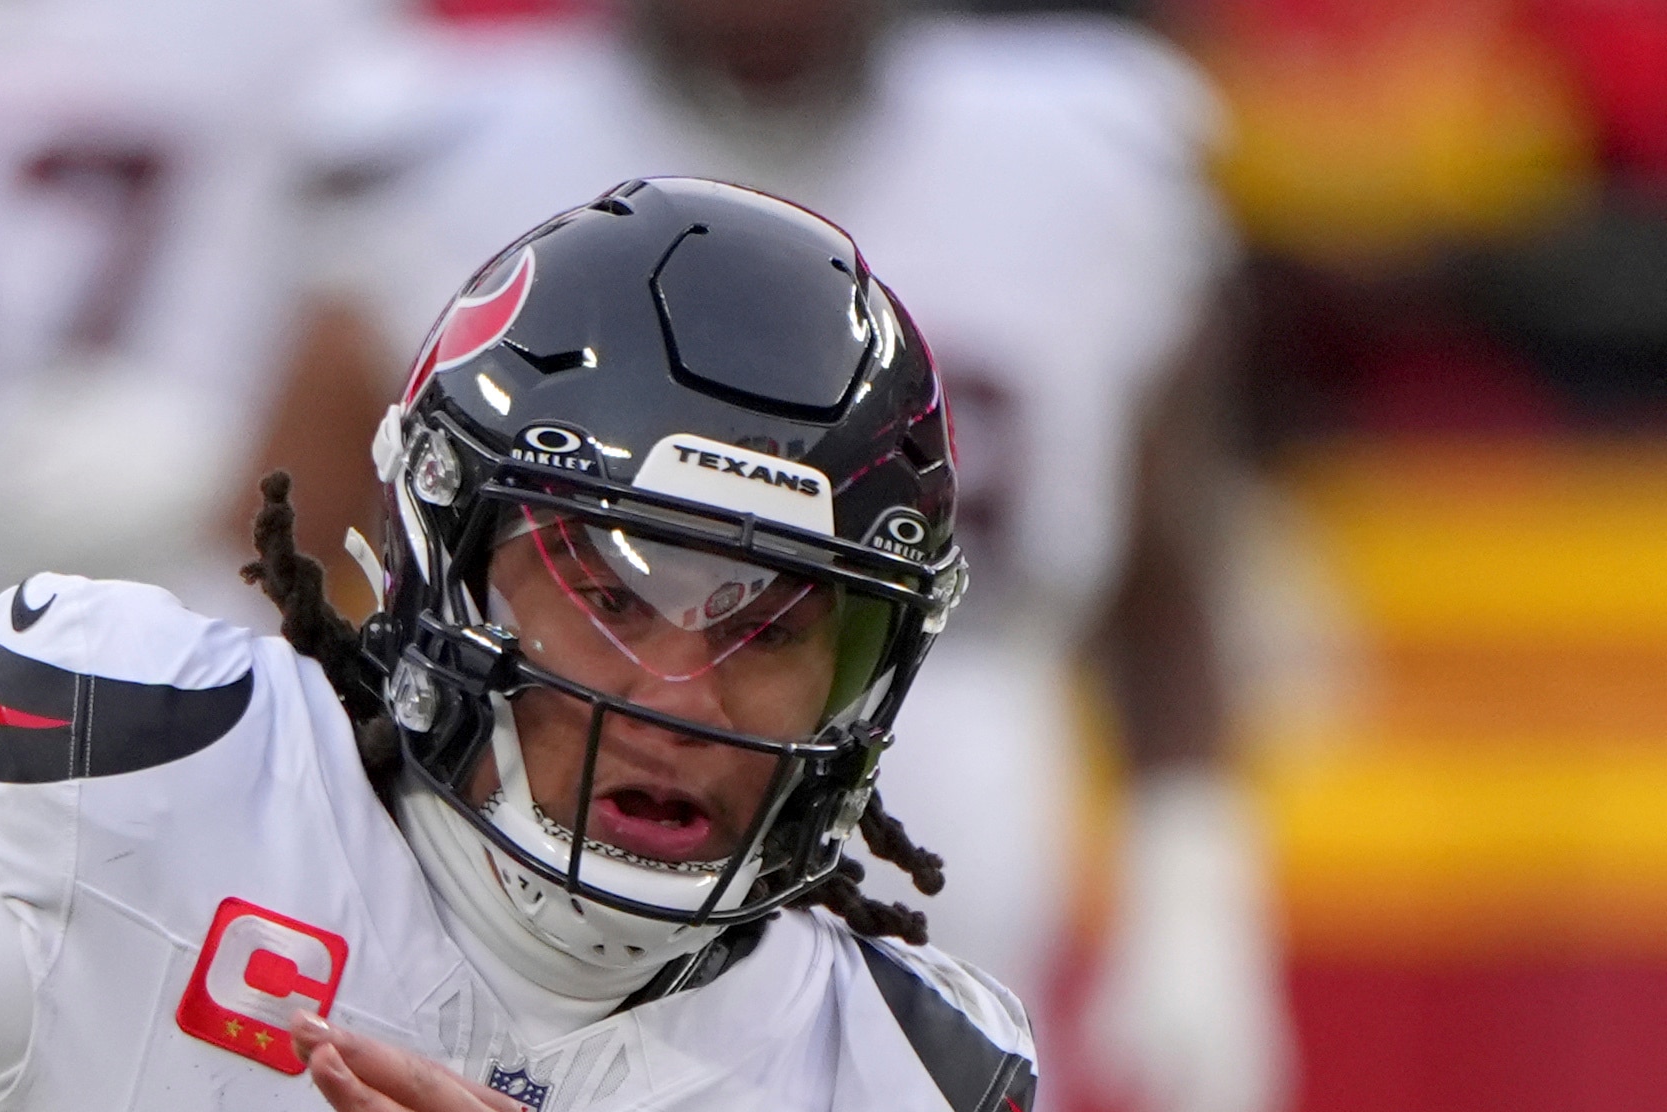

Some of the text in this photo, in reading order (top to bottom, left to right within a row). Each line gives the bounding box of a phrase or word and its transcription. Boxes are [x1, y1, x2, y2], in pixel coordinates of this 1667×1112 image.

[511, 448, 593, 471] OAKLEY
[672, 444, 821, 497] TEXANS
[873, 535, 925, 562] OAKLEY
[205, 914, 332, 1031] C
